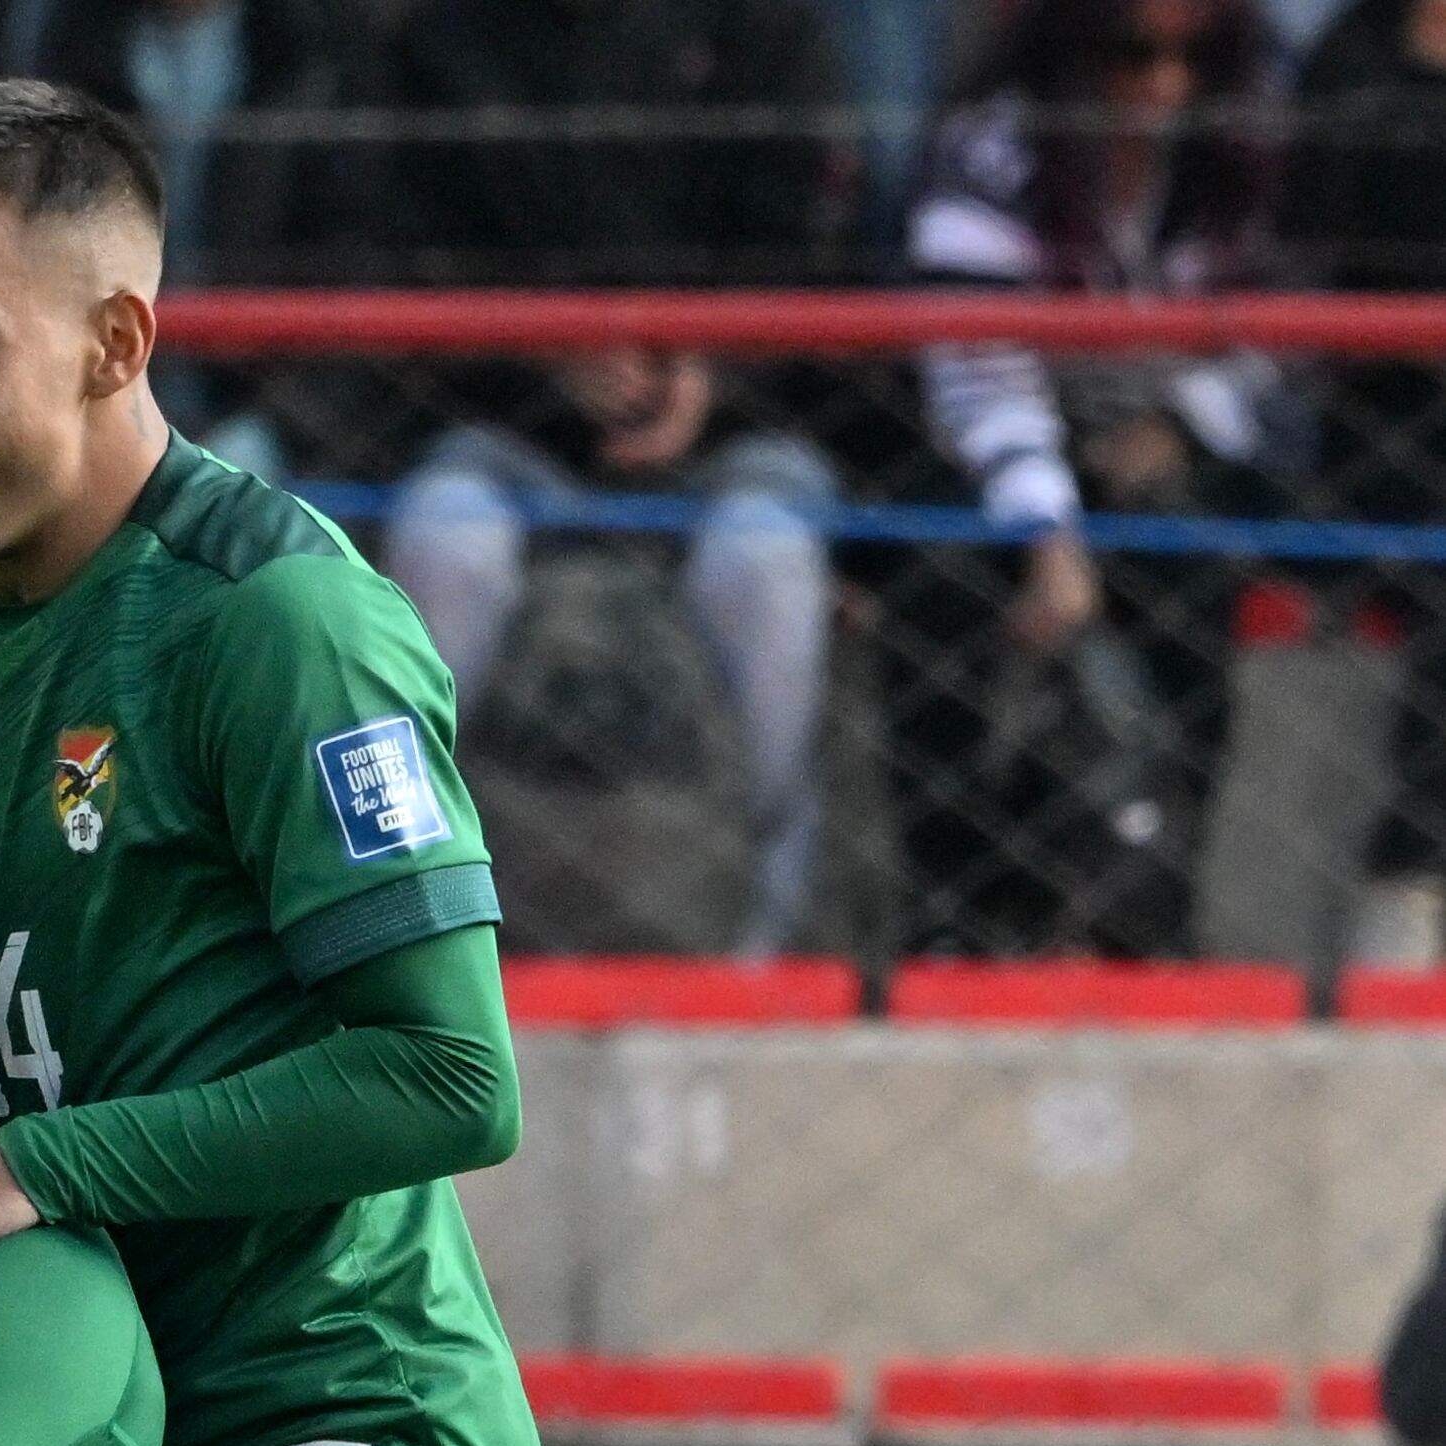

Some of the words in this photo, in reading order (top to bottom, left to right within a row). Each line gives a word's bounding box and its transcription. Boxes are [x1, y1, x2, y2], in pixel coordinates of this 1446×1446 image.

[340, 738, 403, 770] FOOTBALL
[346, 755, 408, 794] UNITES
[351, 791, 379, 816] the
[72, 813, 93, 841] FBF
[383, 813, 408, 828] FIF
